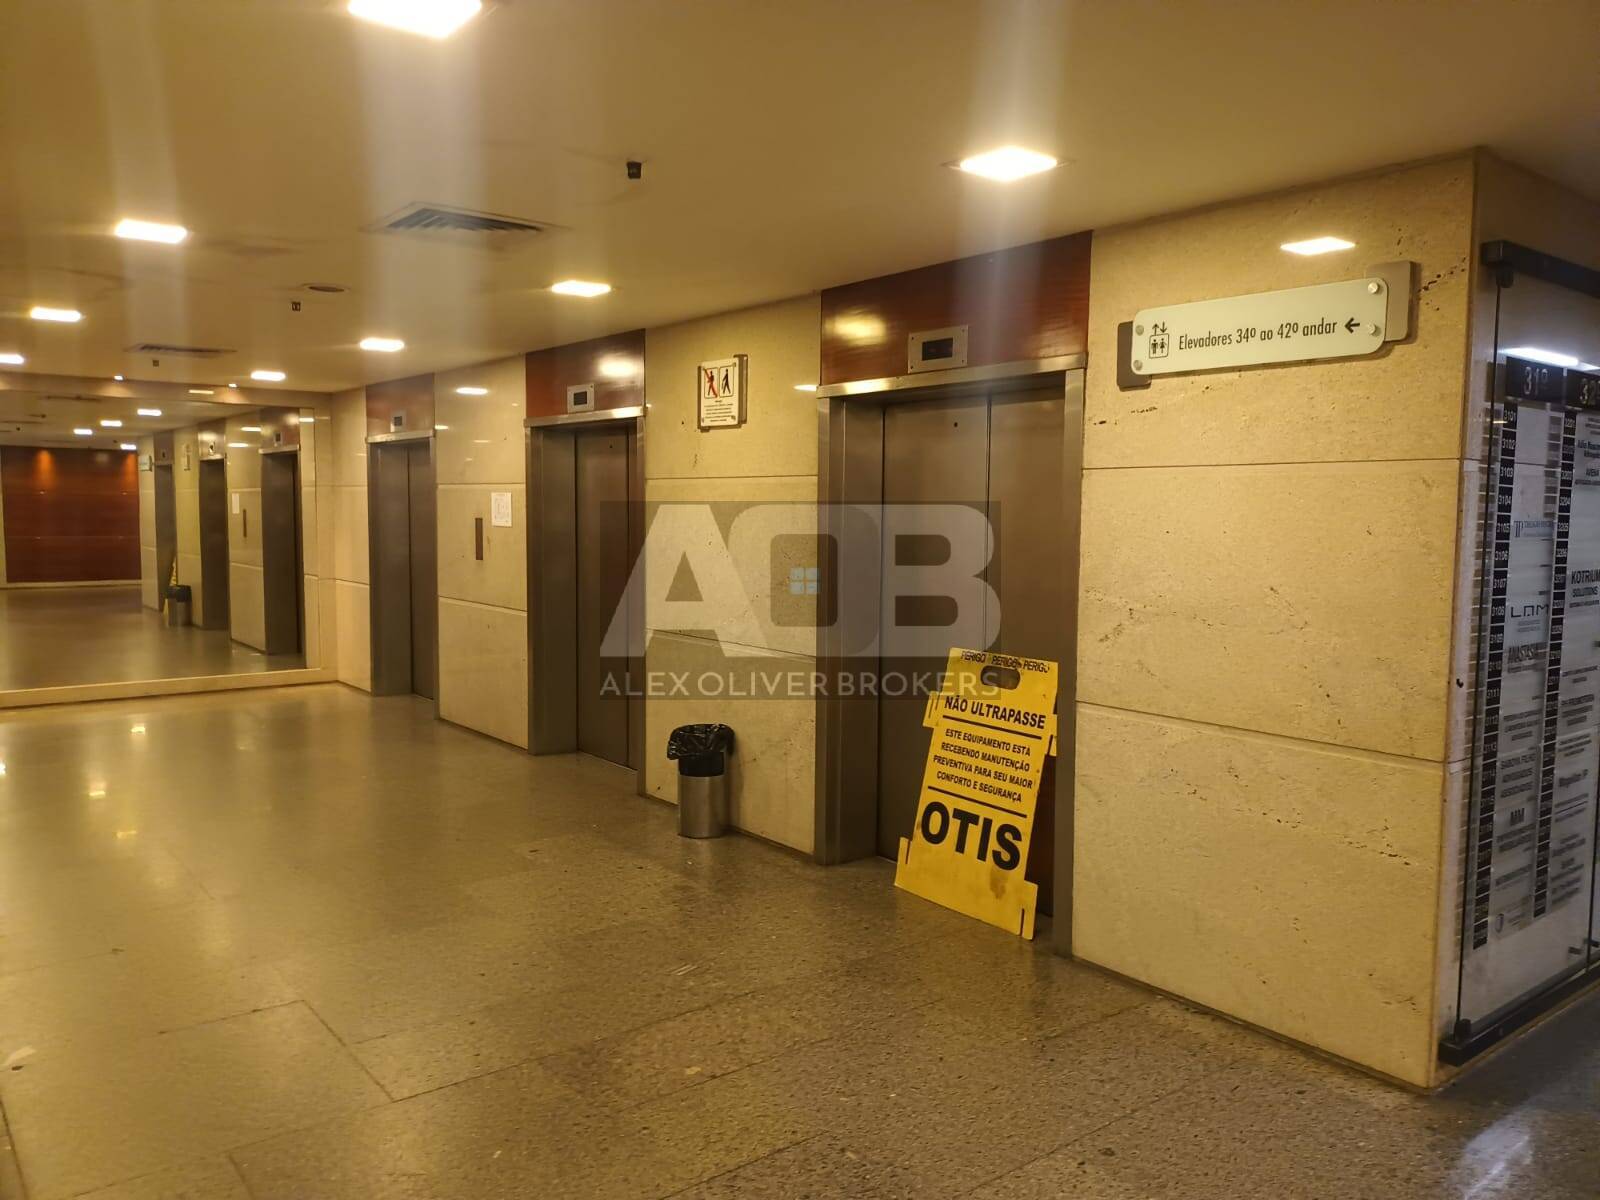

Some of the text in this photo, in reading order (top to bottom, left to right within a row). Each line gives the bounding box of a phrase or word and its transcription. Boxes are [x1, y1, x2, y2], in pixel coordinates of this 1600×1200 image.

[1178, 317, 1337, 351] Elevadores 34º ao 42º andar
[961, 650, 987, 664] PERIGO
[1023, 660, 1050, 673] PERIGO
[944, 695, 1046, 729] NÃO ULTRAPASSE
[945, 728, 962, 740] ESTE
[963, 732, 1010, 752] EQUIPAMENTO
[933, 755, 1033, 789] PREVENTIVA PARA SEU MAIOR
[941, 742, 1030, 772] RECEBENDO MANUTENÇÃO
[936, 771, 1022, 803] CONFORTO E SEGURANÇA
[921, 801, 1022, 871] OTIS
